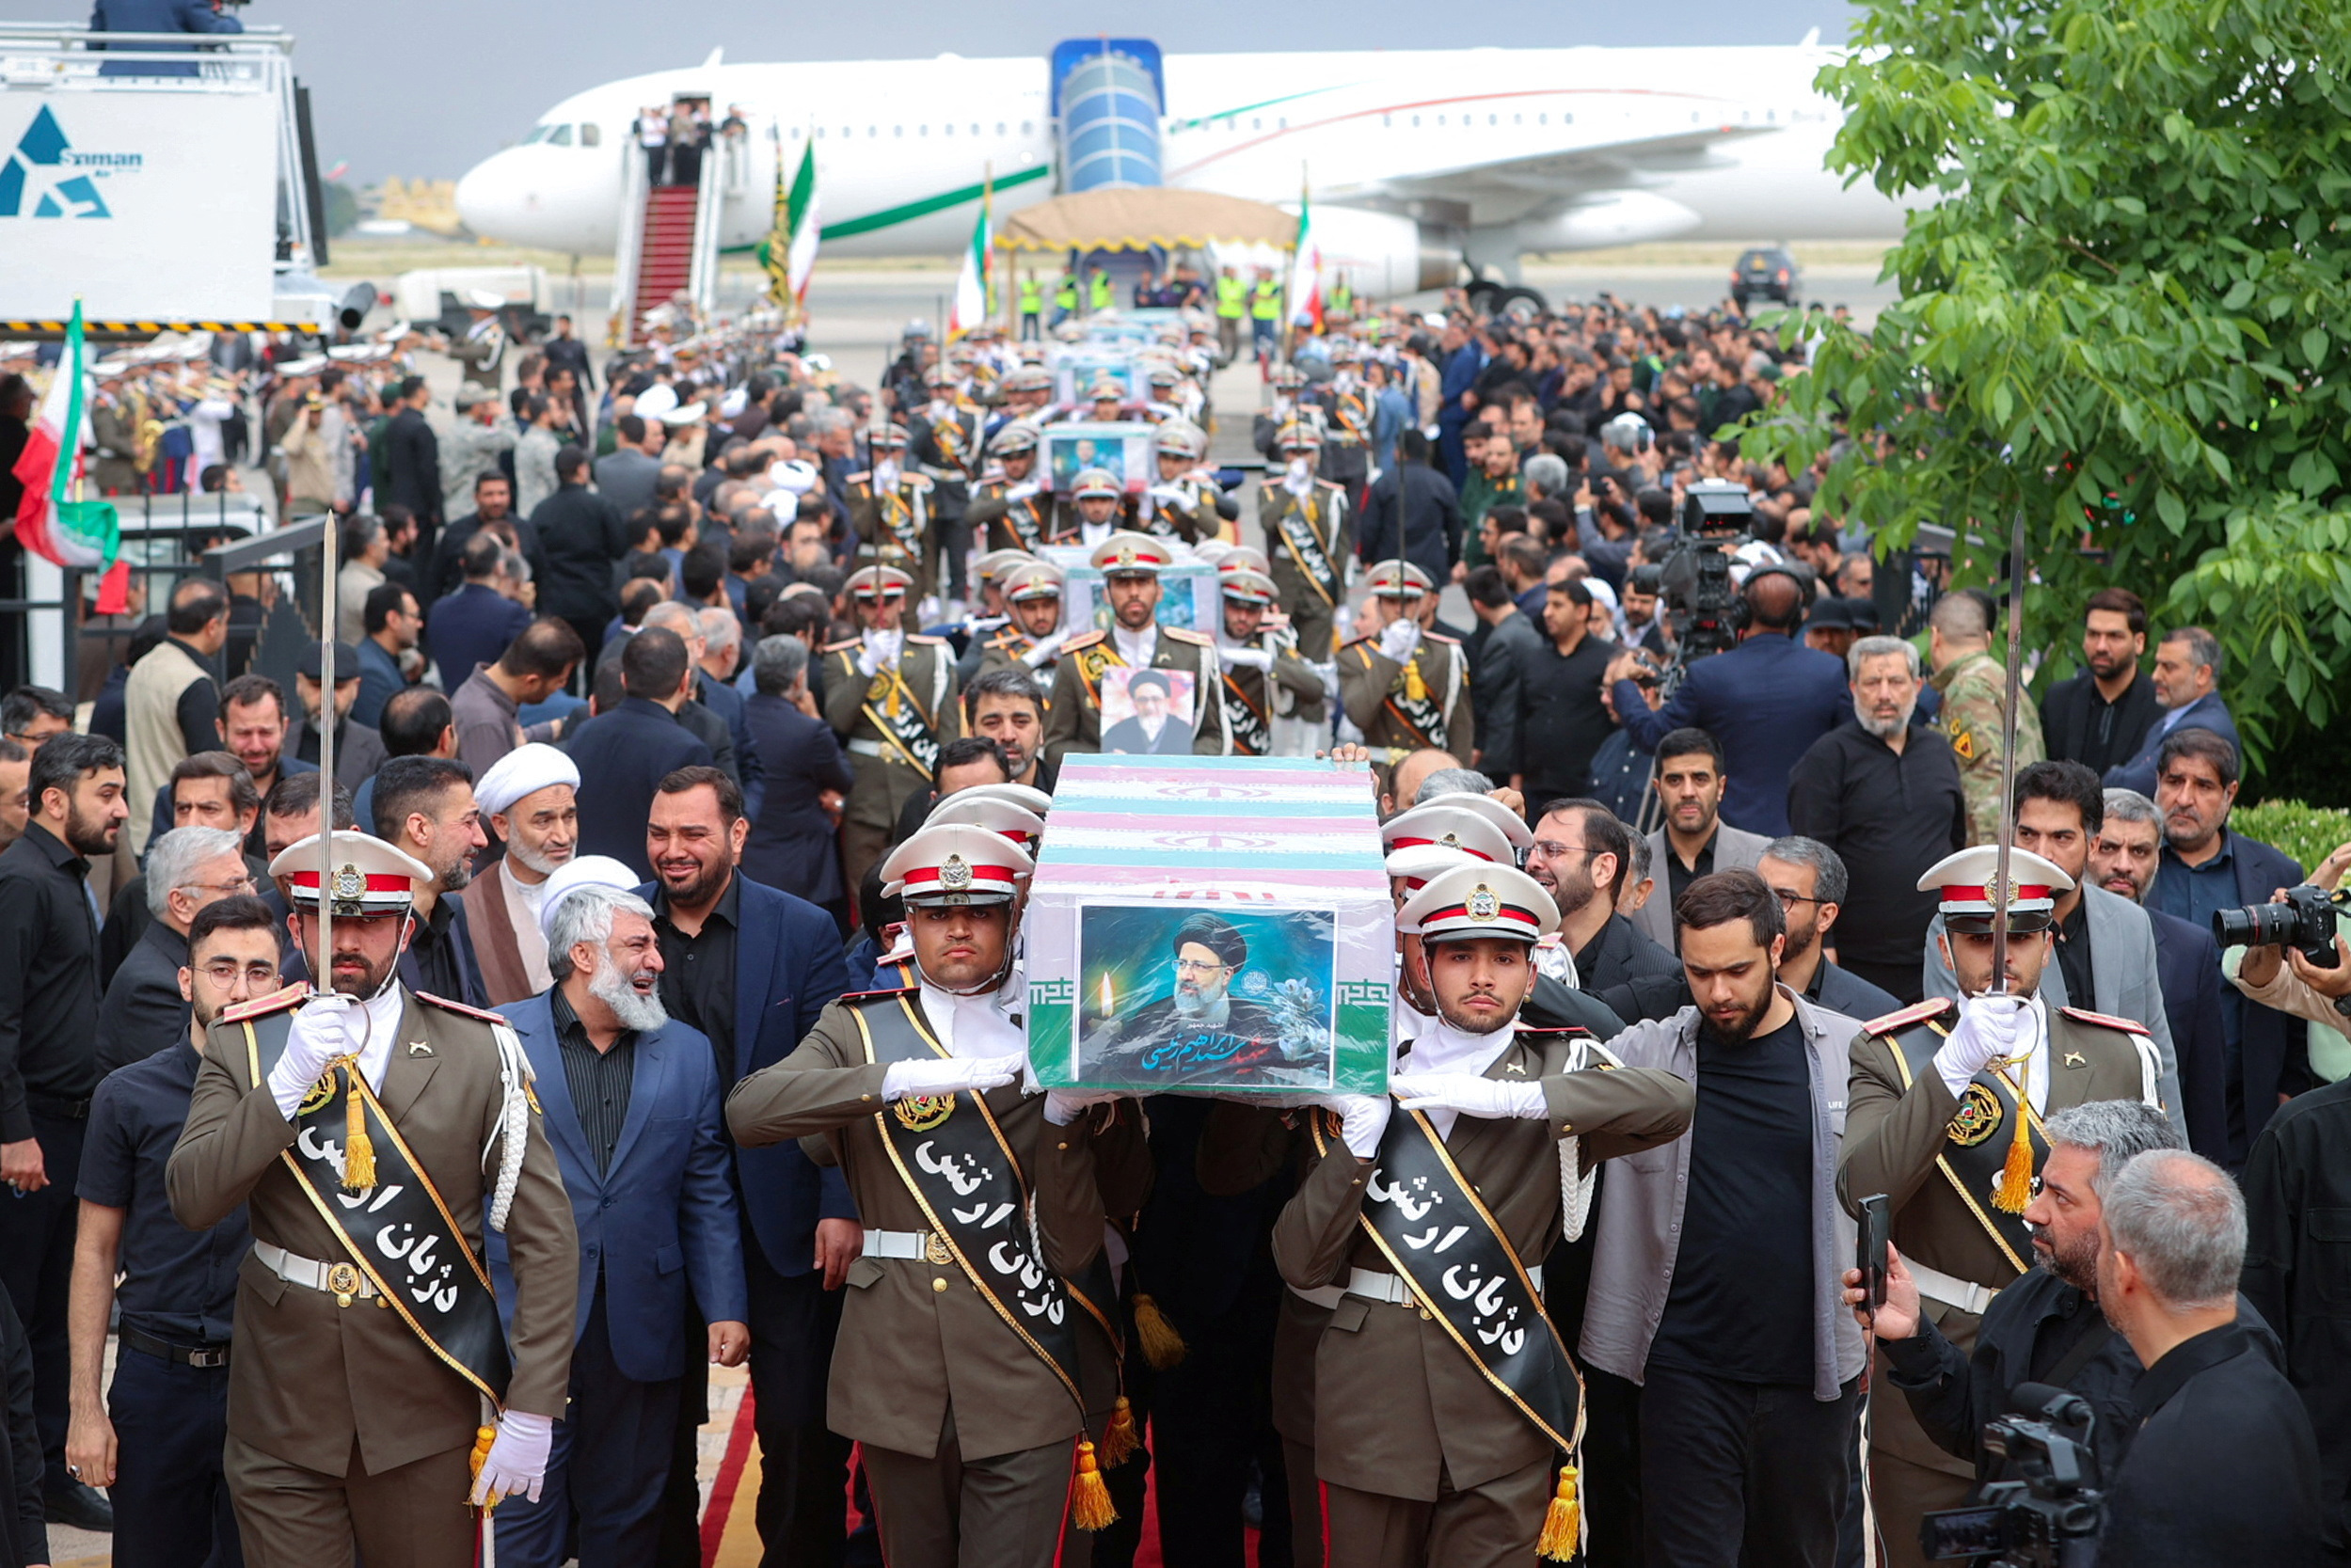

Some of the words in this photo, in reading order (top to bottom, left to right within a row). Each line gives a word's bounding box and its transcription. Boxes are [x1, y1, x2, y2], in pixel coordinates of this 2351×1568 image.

[58, 148, 143, 166] Saman
[1828, 1101, 1843, 1109] LIFE
[914, 1139, 1017, 1229] ارتش
[1365, 1167, 1470, 1255] ارتش
[375, 1222, 458, 1314] دژبان
[1441, 1262, 1526, 1356] دژبان
